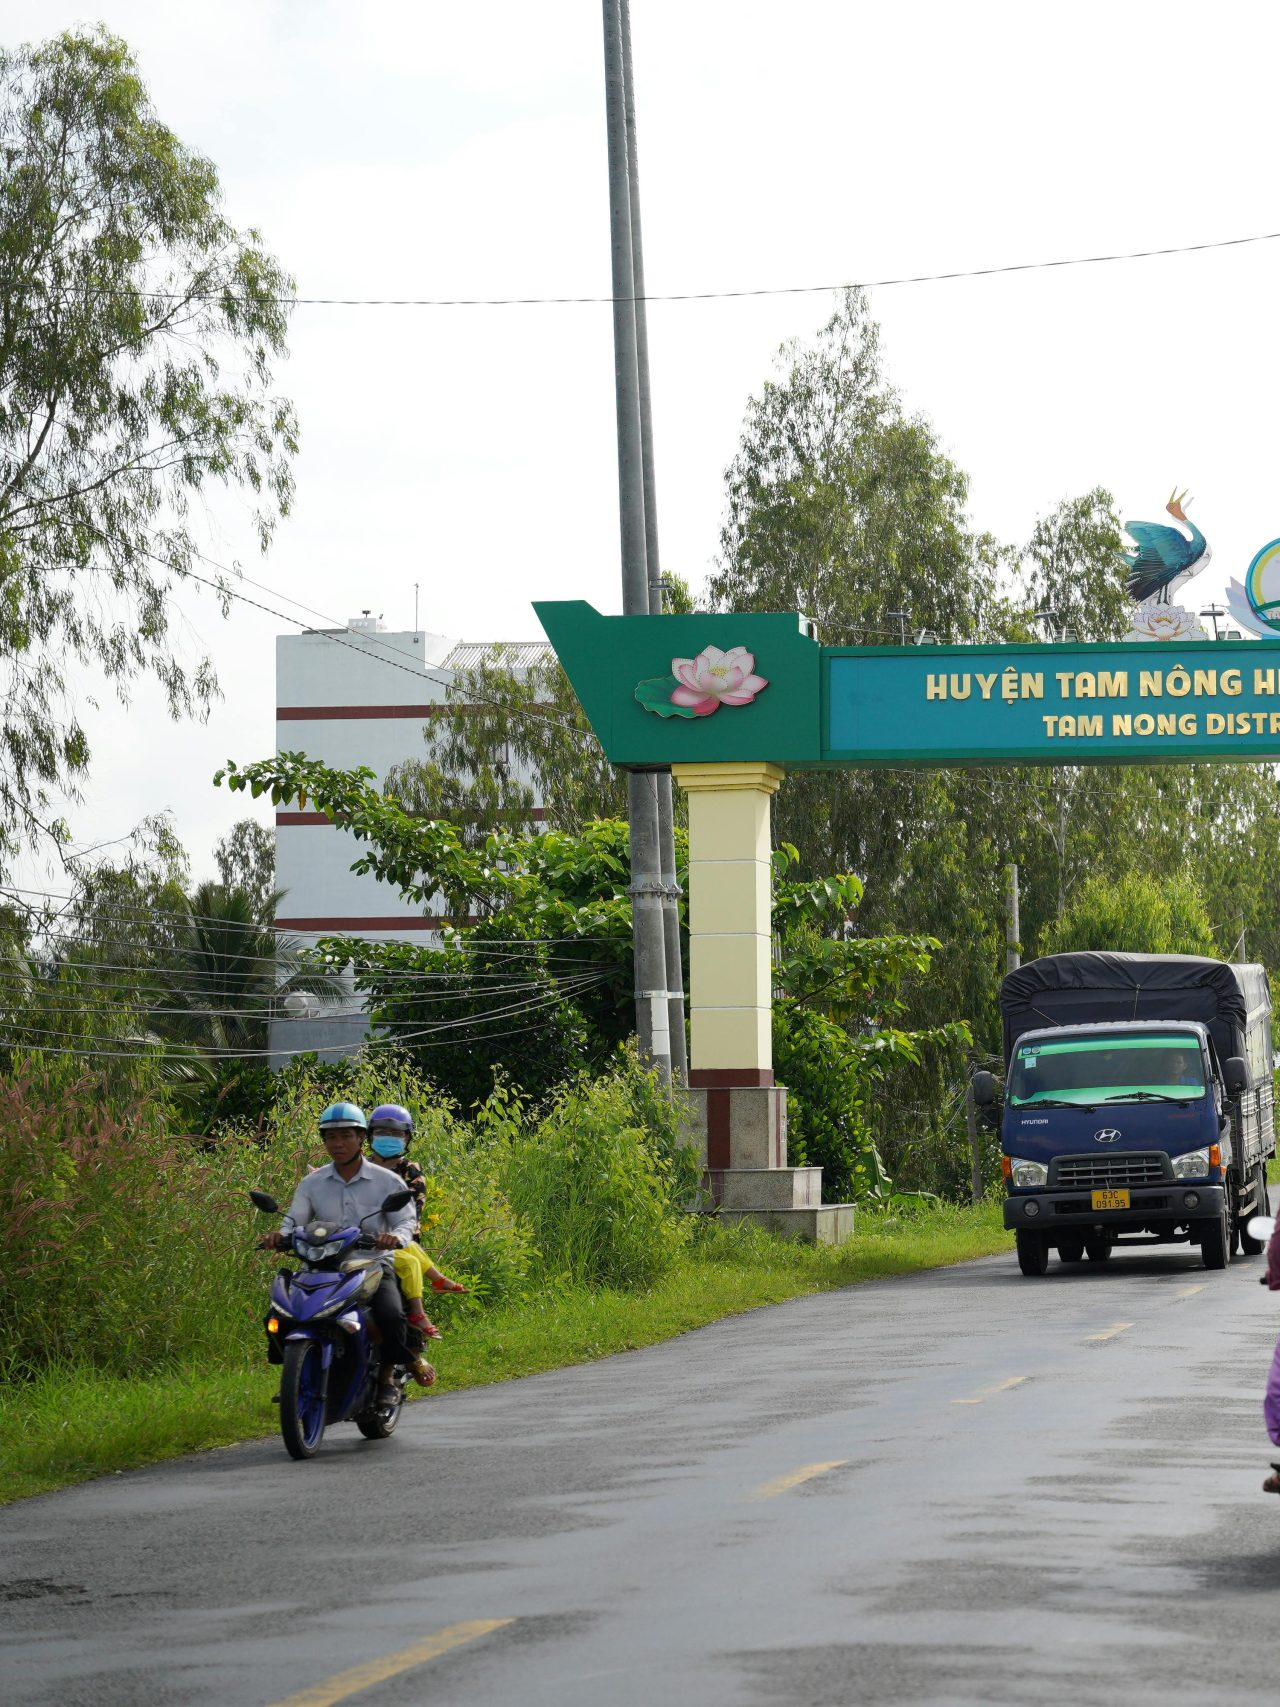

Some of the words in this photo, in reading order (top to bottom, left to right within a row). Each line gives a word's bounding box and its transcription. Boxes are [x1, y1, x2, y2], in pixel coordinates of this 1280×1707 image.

[926, 666, 1044, 704] HUYỆN
[1055, 671, 1128, 699] TAM
[1139, 664, 1242, 697] NÔNG
[1043, 715, 1103, 738] TAM
[1112, 713, 1198, 737] NONG
[1103, 1191, 1118, 1199] 63C
[1097, 1200, 1126, 1208] 091.95
